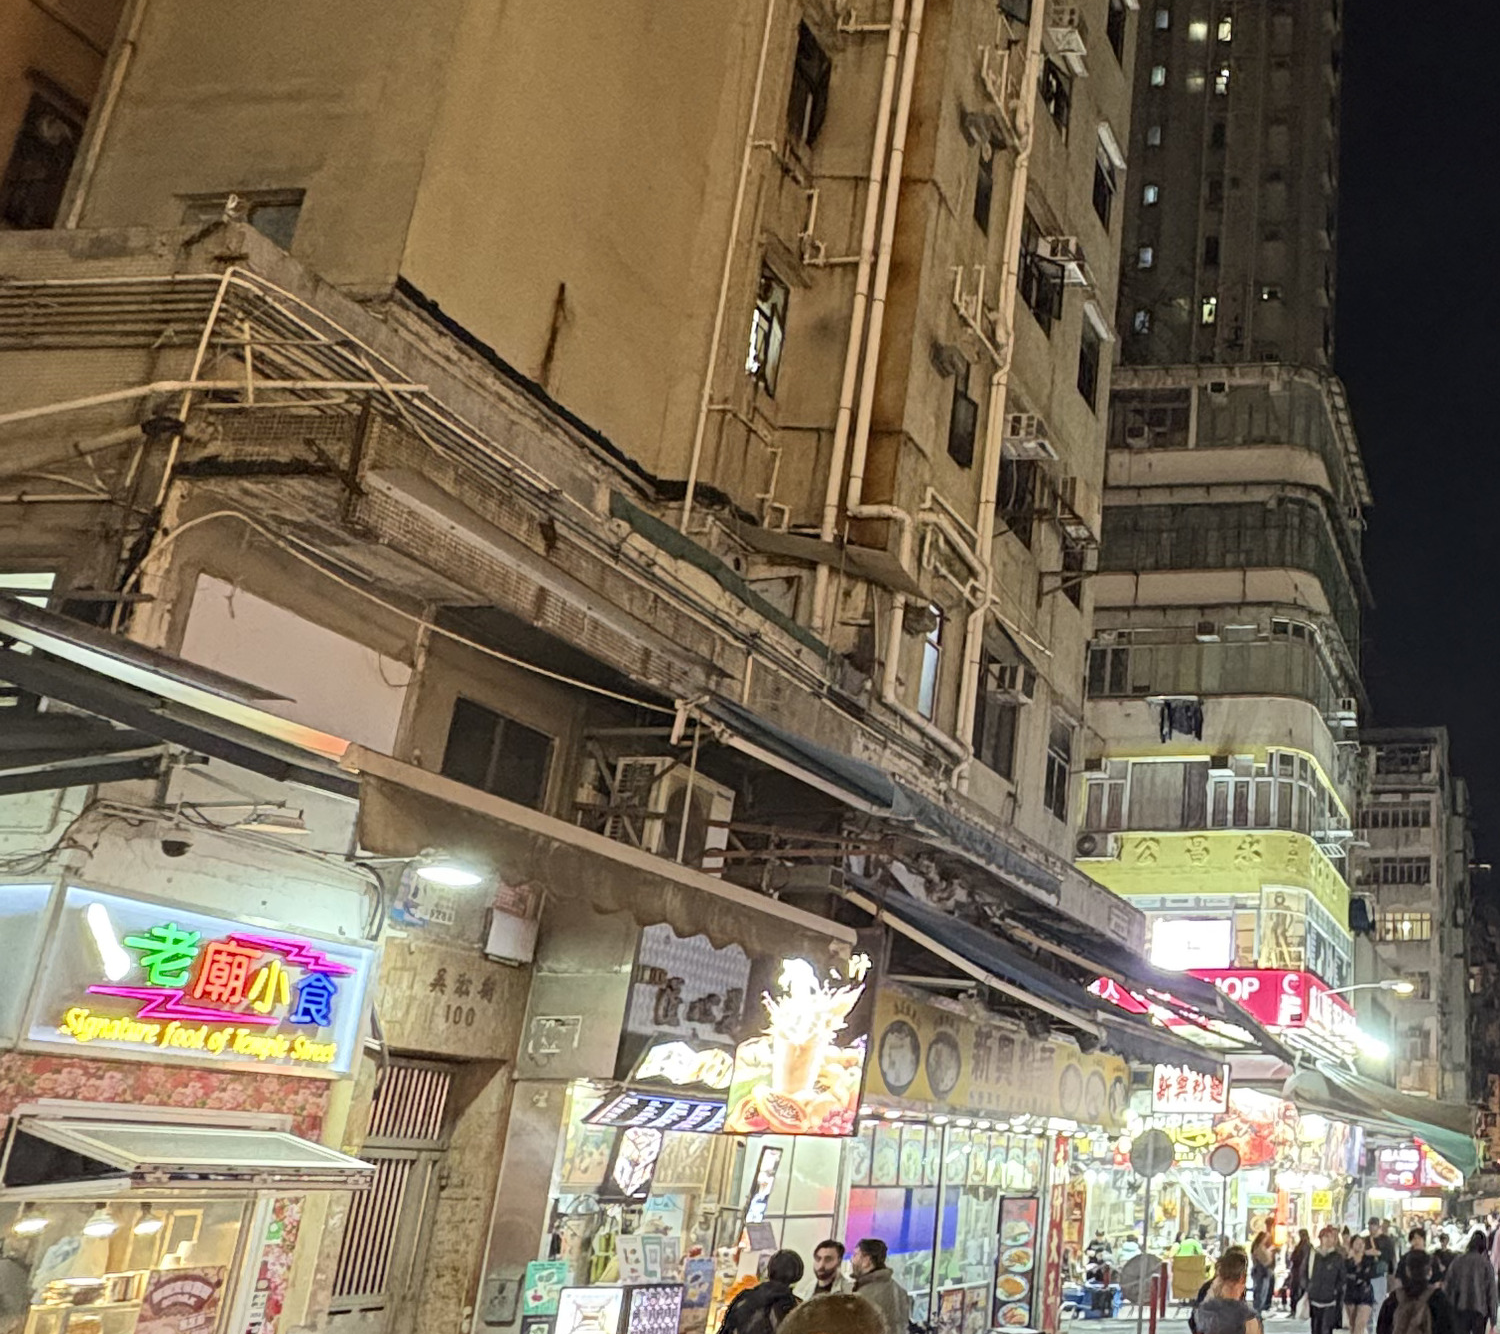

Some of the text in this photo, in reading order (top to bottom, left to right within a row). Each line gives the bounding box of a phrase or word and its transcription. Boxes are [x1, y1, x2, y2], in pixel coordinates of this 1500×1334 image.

[124, 922, 338, 1027] 老廟小食
[57, 1007, 338, 1064] Signature food of Temple Street
[445, 1004, 475, 1027] 100
